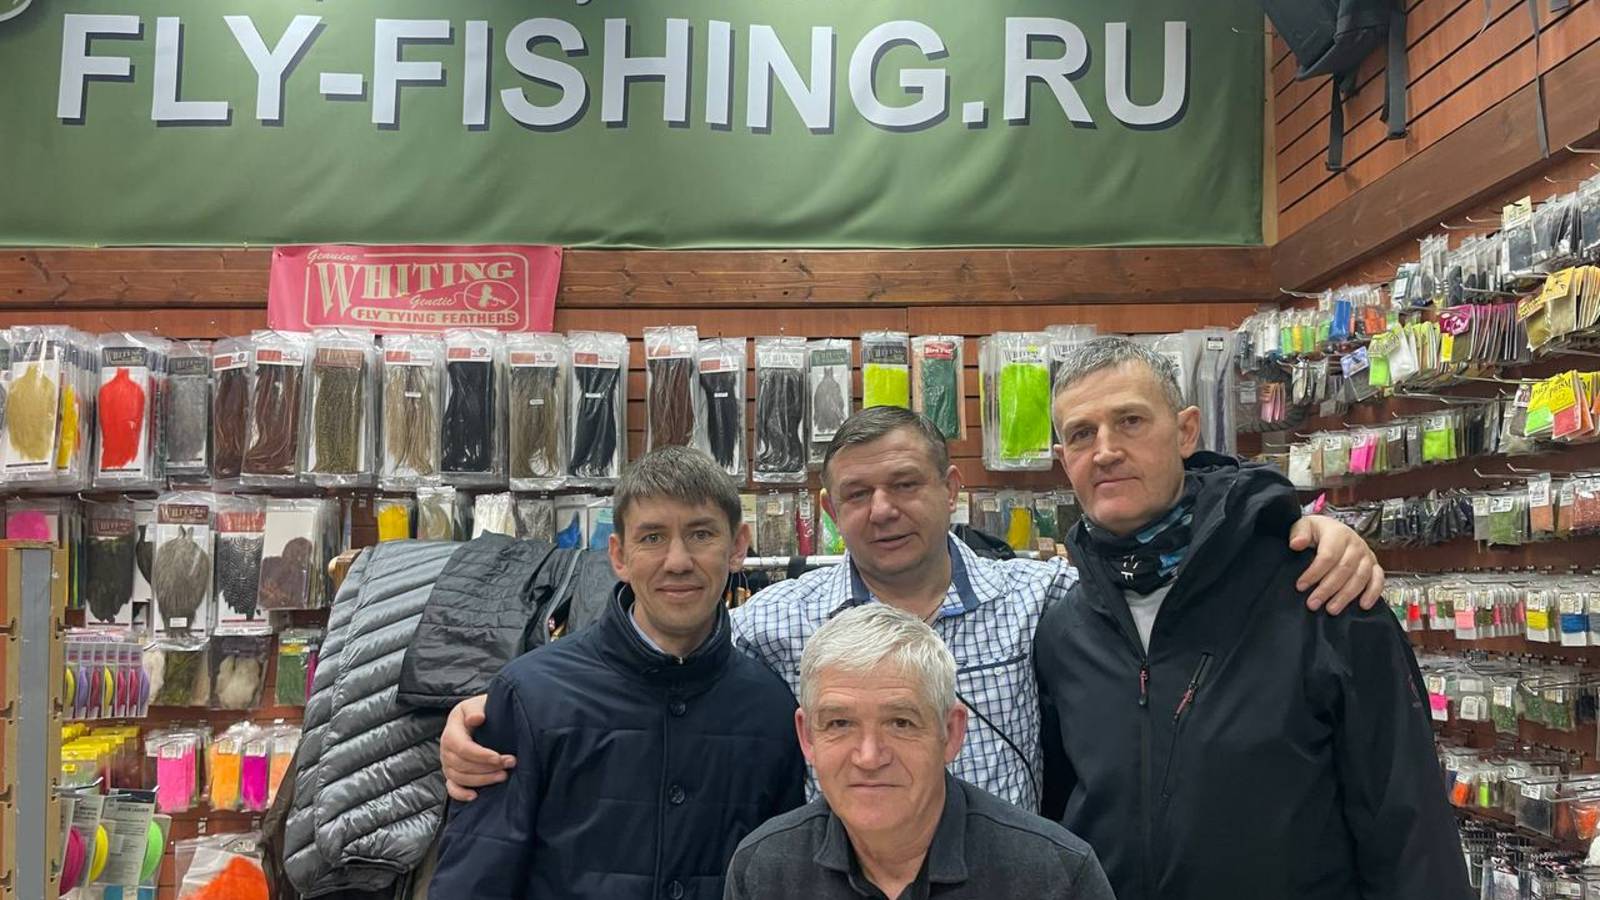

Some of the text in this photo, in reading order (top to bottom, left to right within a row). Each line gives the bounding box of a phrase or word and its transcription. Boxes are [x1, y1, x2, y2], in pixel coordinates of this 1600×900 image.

[57, 14, 1188, 131] FLY-FISHING.RU
[307, 249, 358, 263] Genuine
[317, 261, 515, 317] WHITING
[357, 309, 517, 324] FLY TYING FEATHERS
